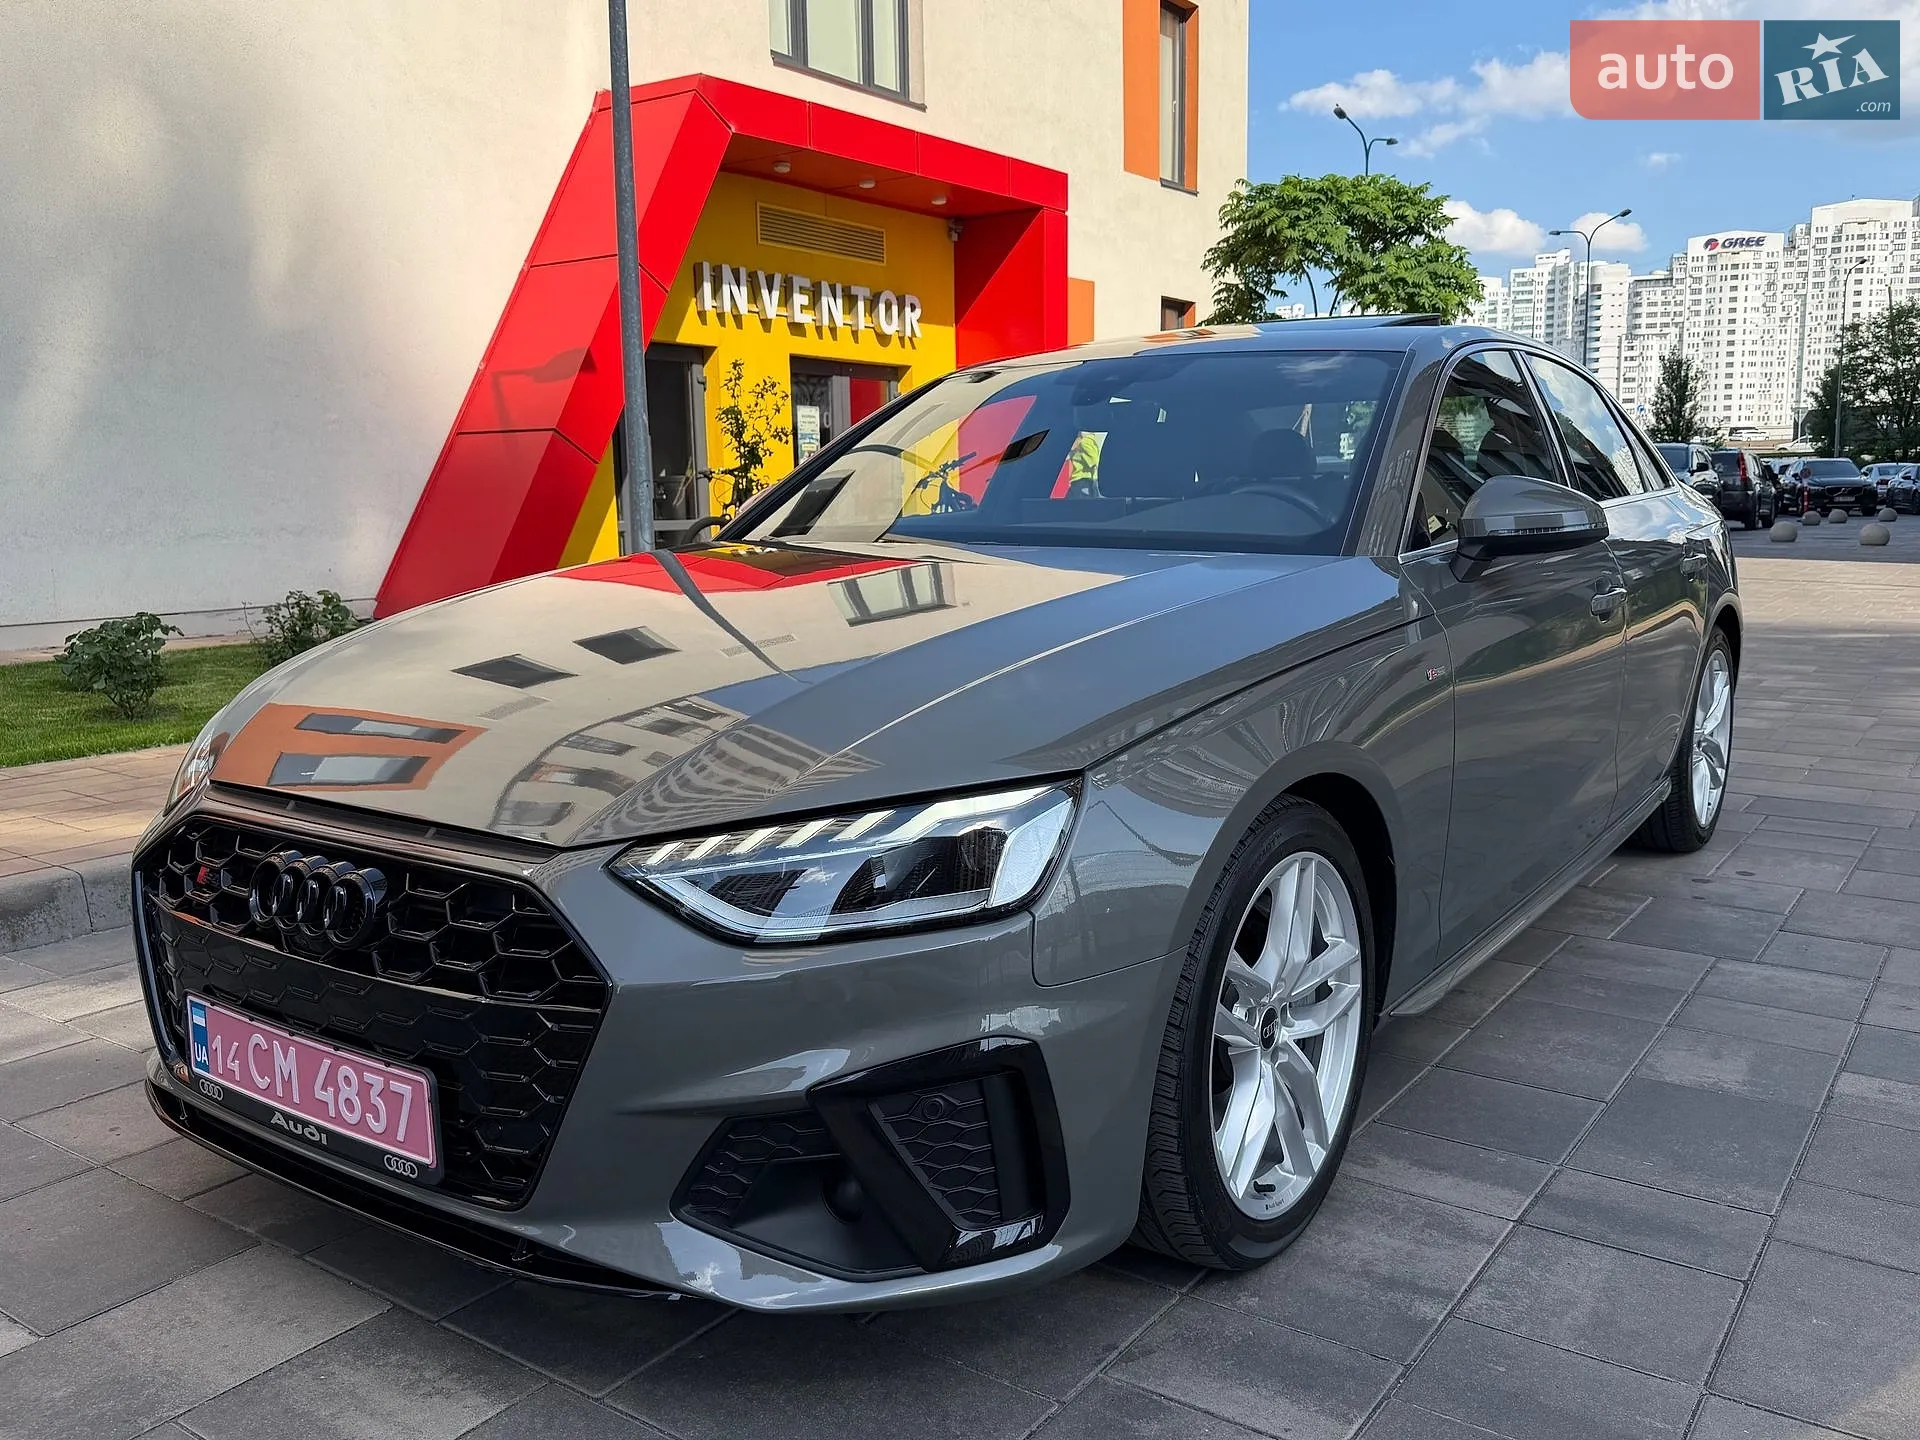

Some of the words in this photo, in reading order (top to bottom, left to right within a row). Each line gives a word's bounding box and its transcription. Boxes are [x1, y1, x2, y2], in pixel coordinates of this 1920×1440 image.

[1720, 235, 1767, 249] GREE
[694, 260, 923, 338] INVENTOR
[194, 1041, 209, 1066] UA
[211, 1034, 241, 1081] 14
[247, 1033, 300, 1104] CM
[313, 1058, 412, 1143] 4837
[270, 1110, 328, 1146] Audi
